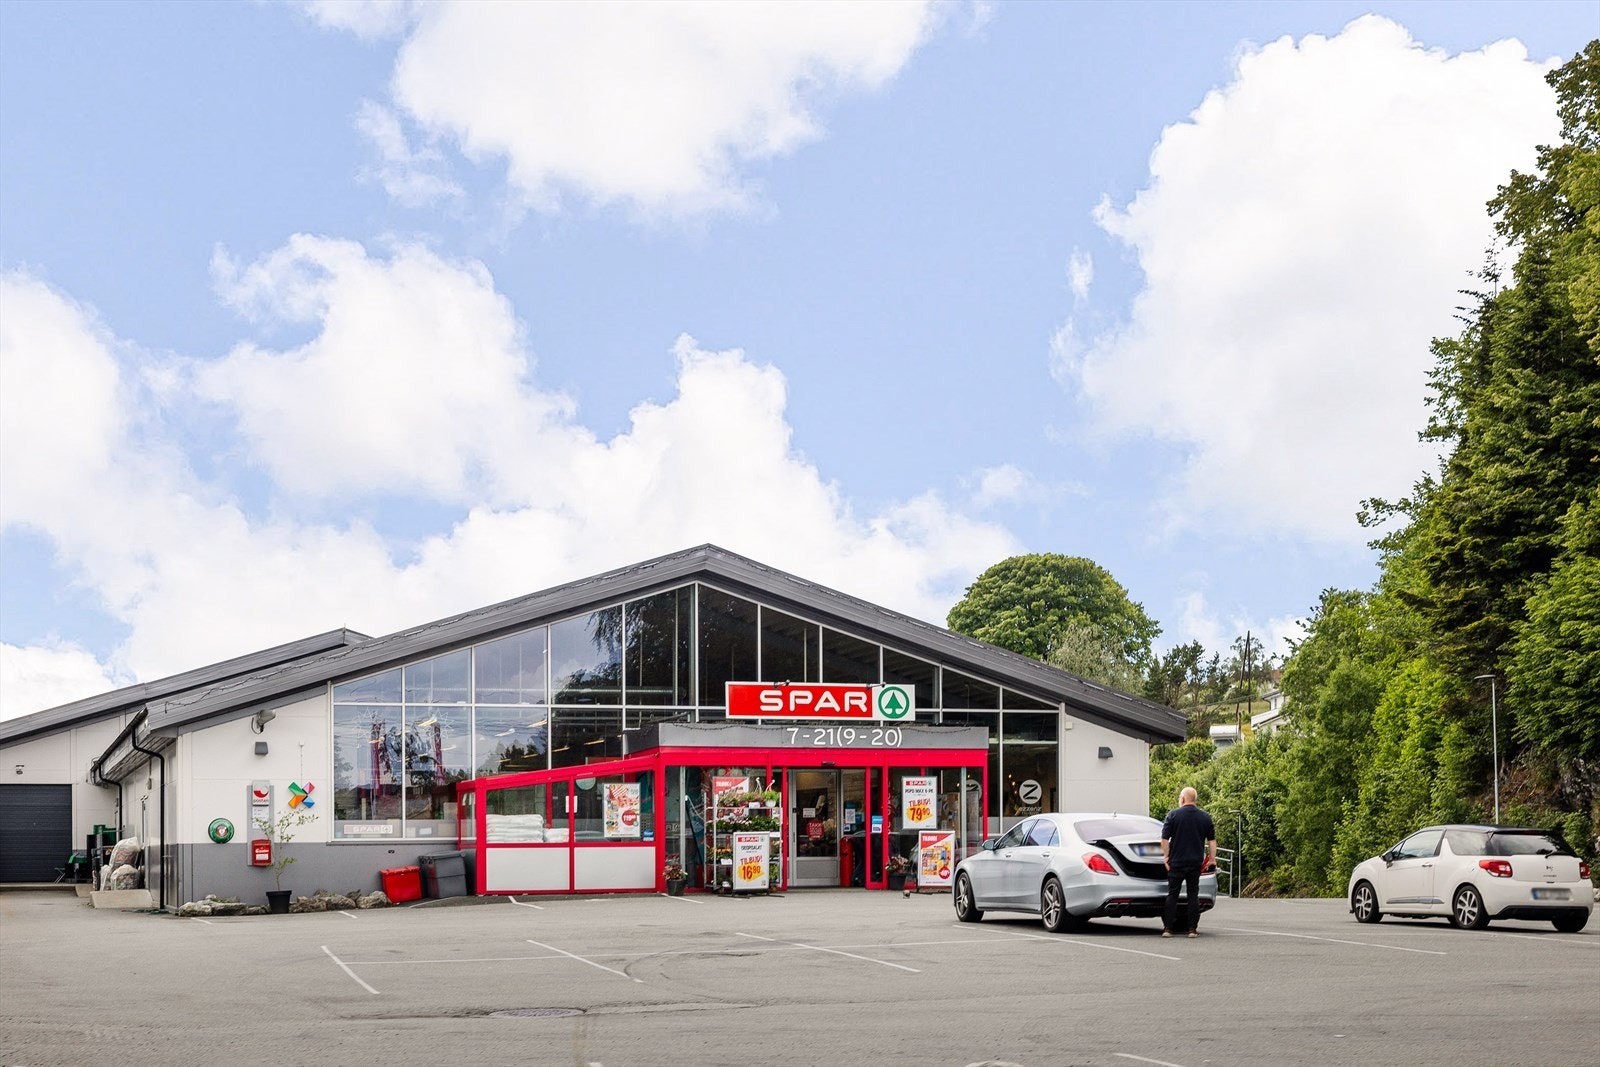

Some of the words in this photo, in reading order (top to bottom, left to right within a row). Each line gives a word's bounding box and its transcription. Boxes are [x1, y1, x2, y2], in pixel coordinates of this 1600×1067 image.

[759, 690, 868, 713] SPAR
[908, 798, 931, 807] TILBUD!
[740, 855, 763, 865] TILBUD!
